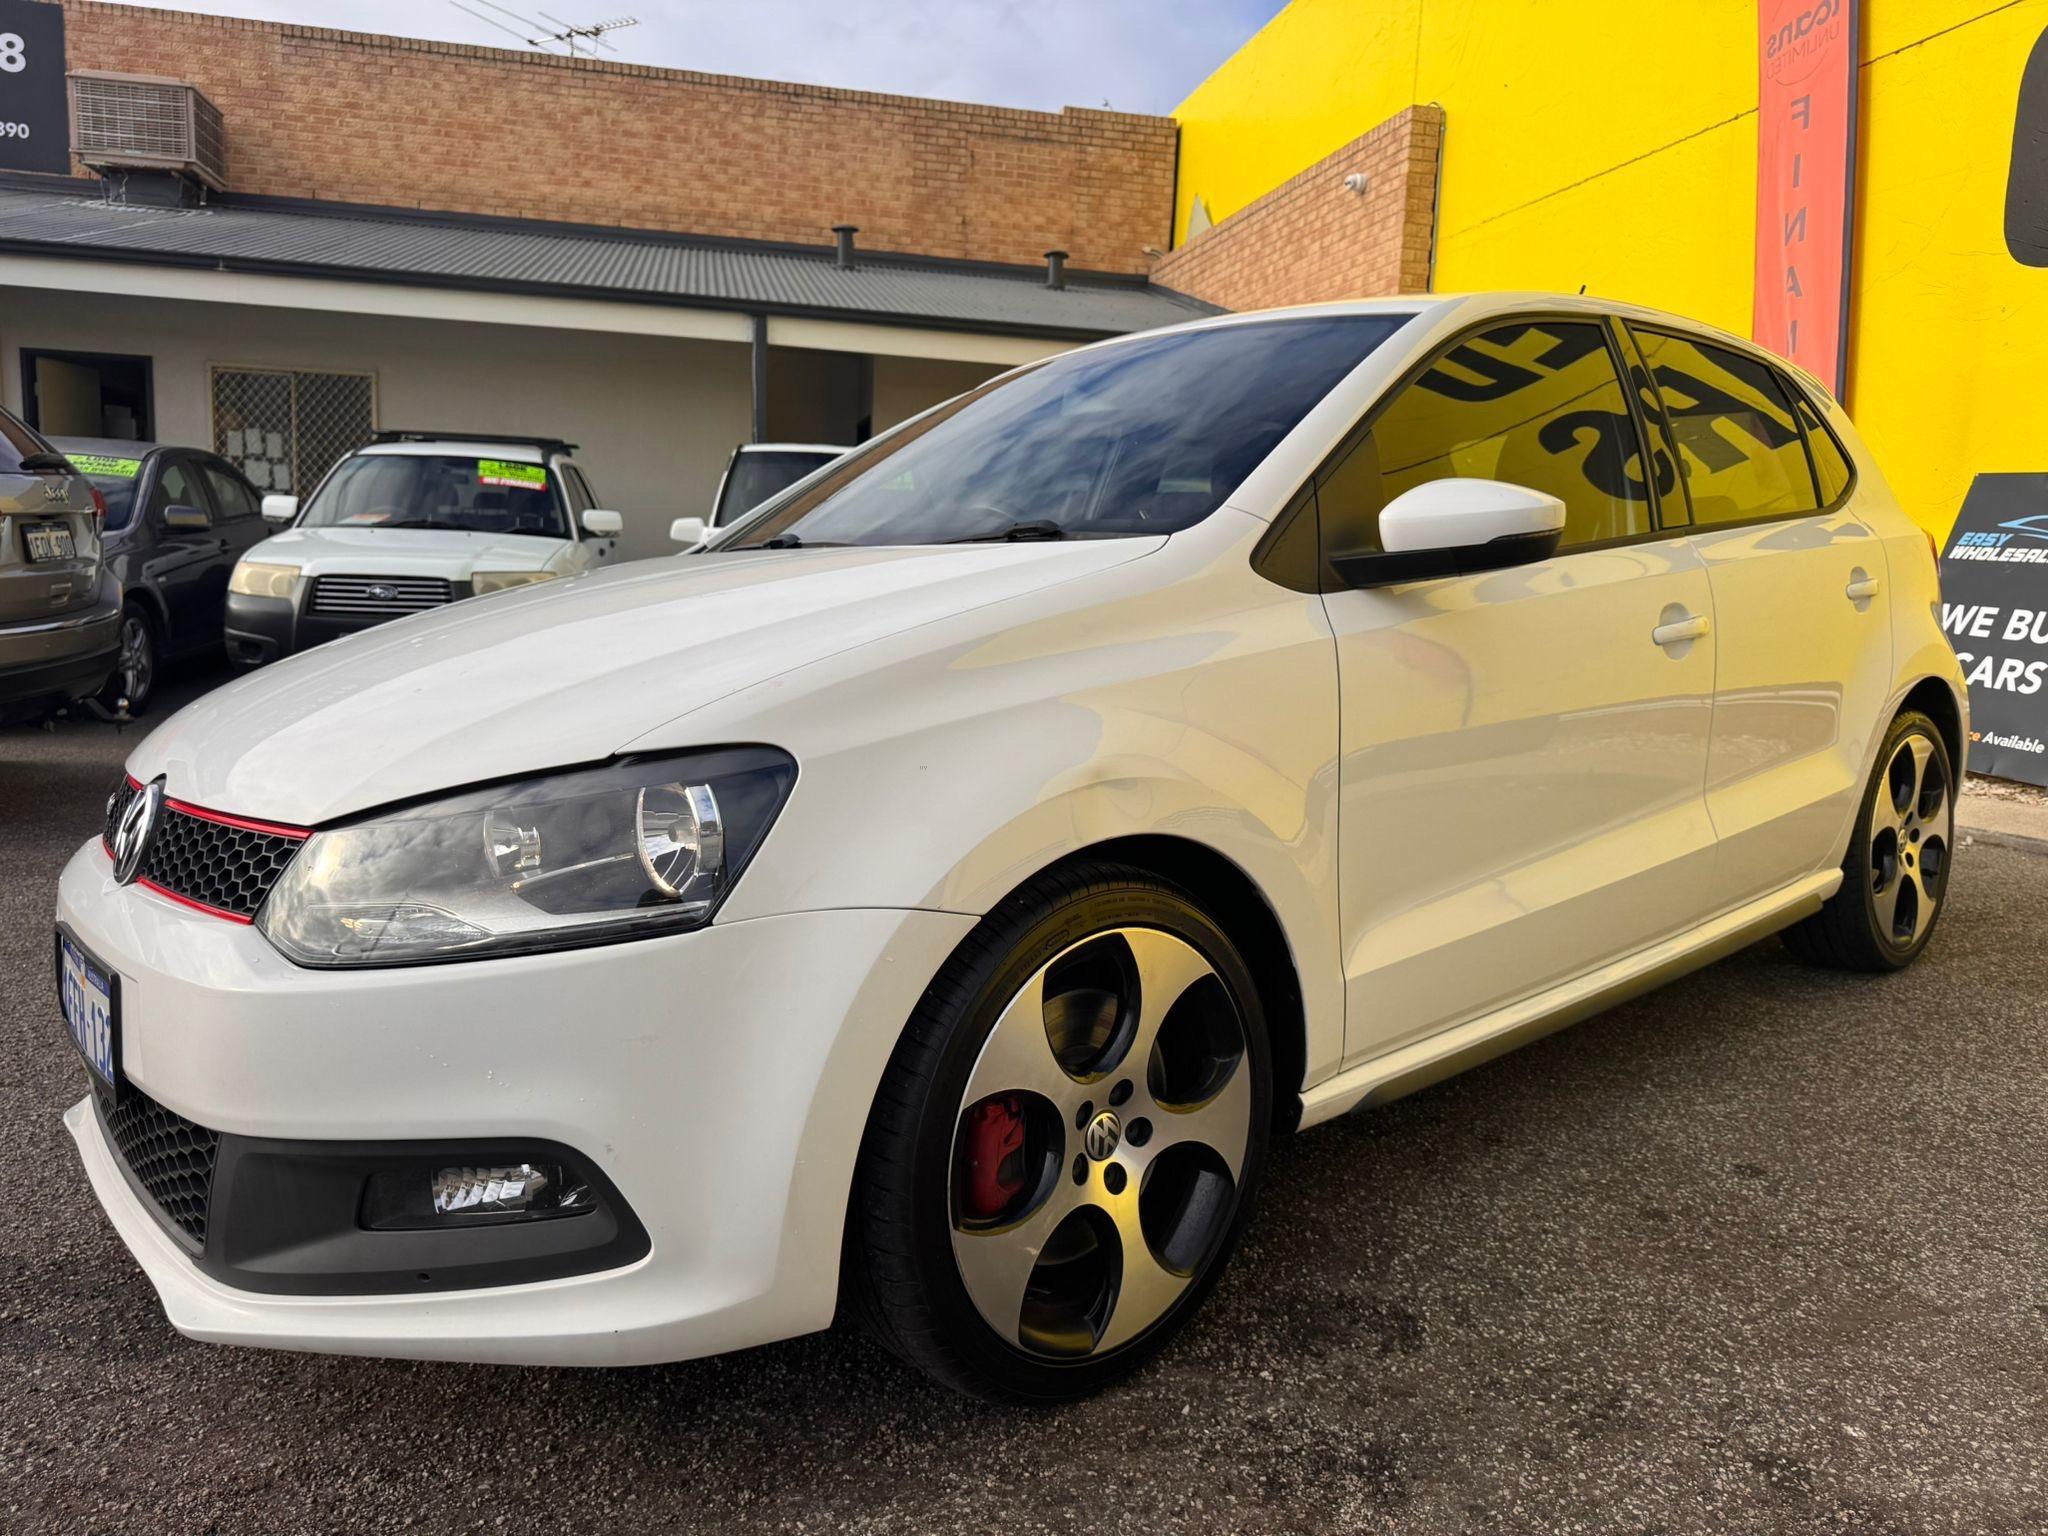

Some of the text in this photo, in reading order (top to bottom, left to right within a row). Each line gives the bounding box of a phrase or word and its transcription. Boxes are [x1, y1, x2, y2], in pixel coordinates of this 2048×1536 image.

[1957, 531, 2015, 547] EASY
[1942, 603, 2000, 638] WE
[1981, 731, 2045, 754] Available
